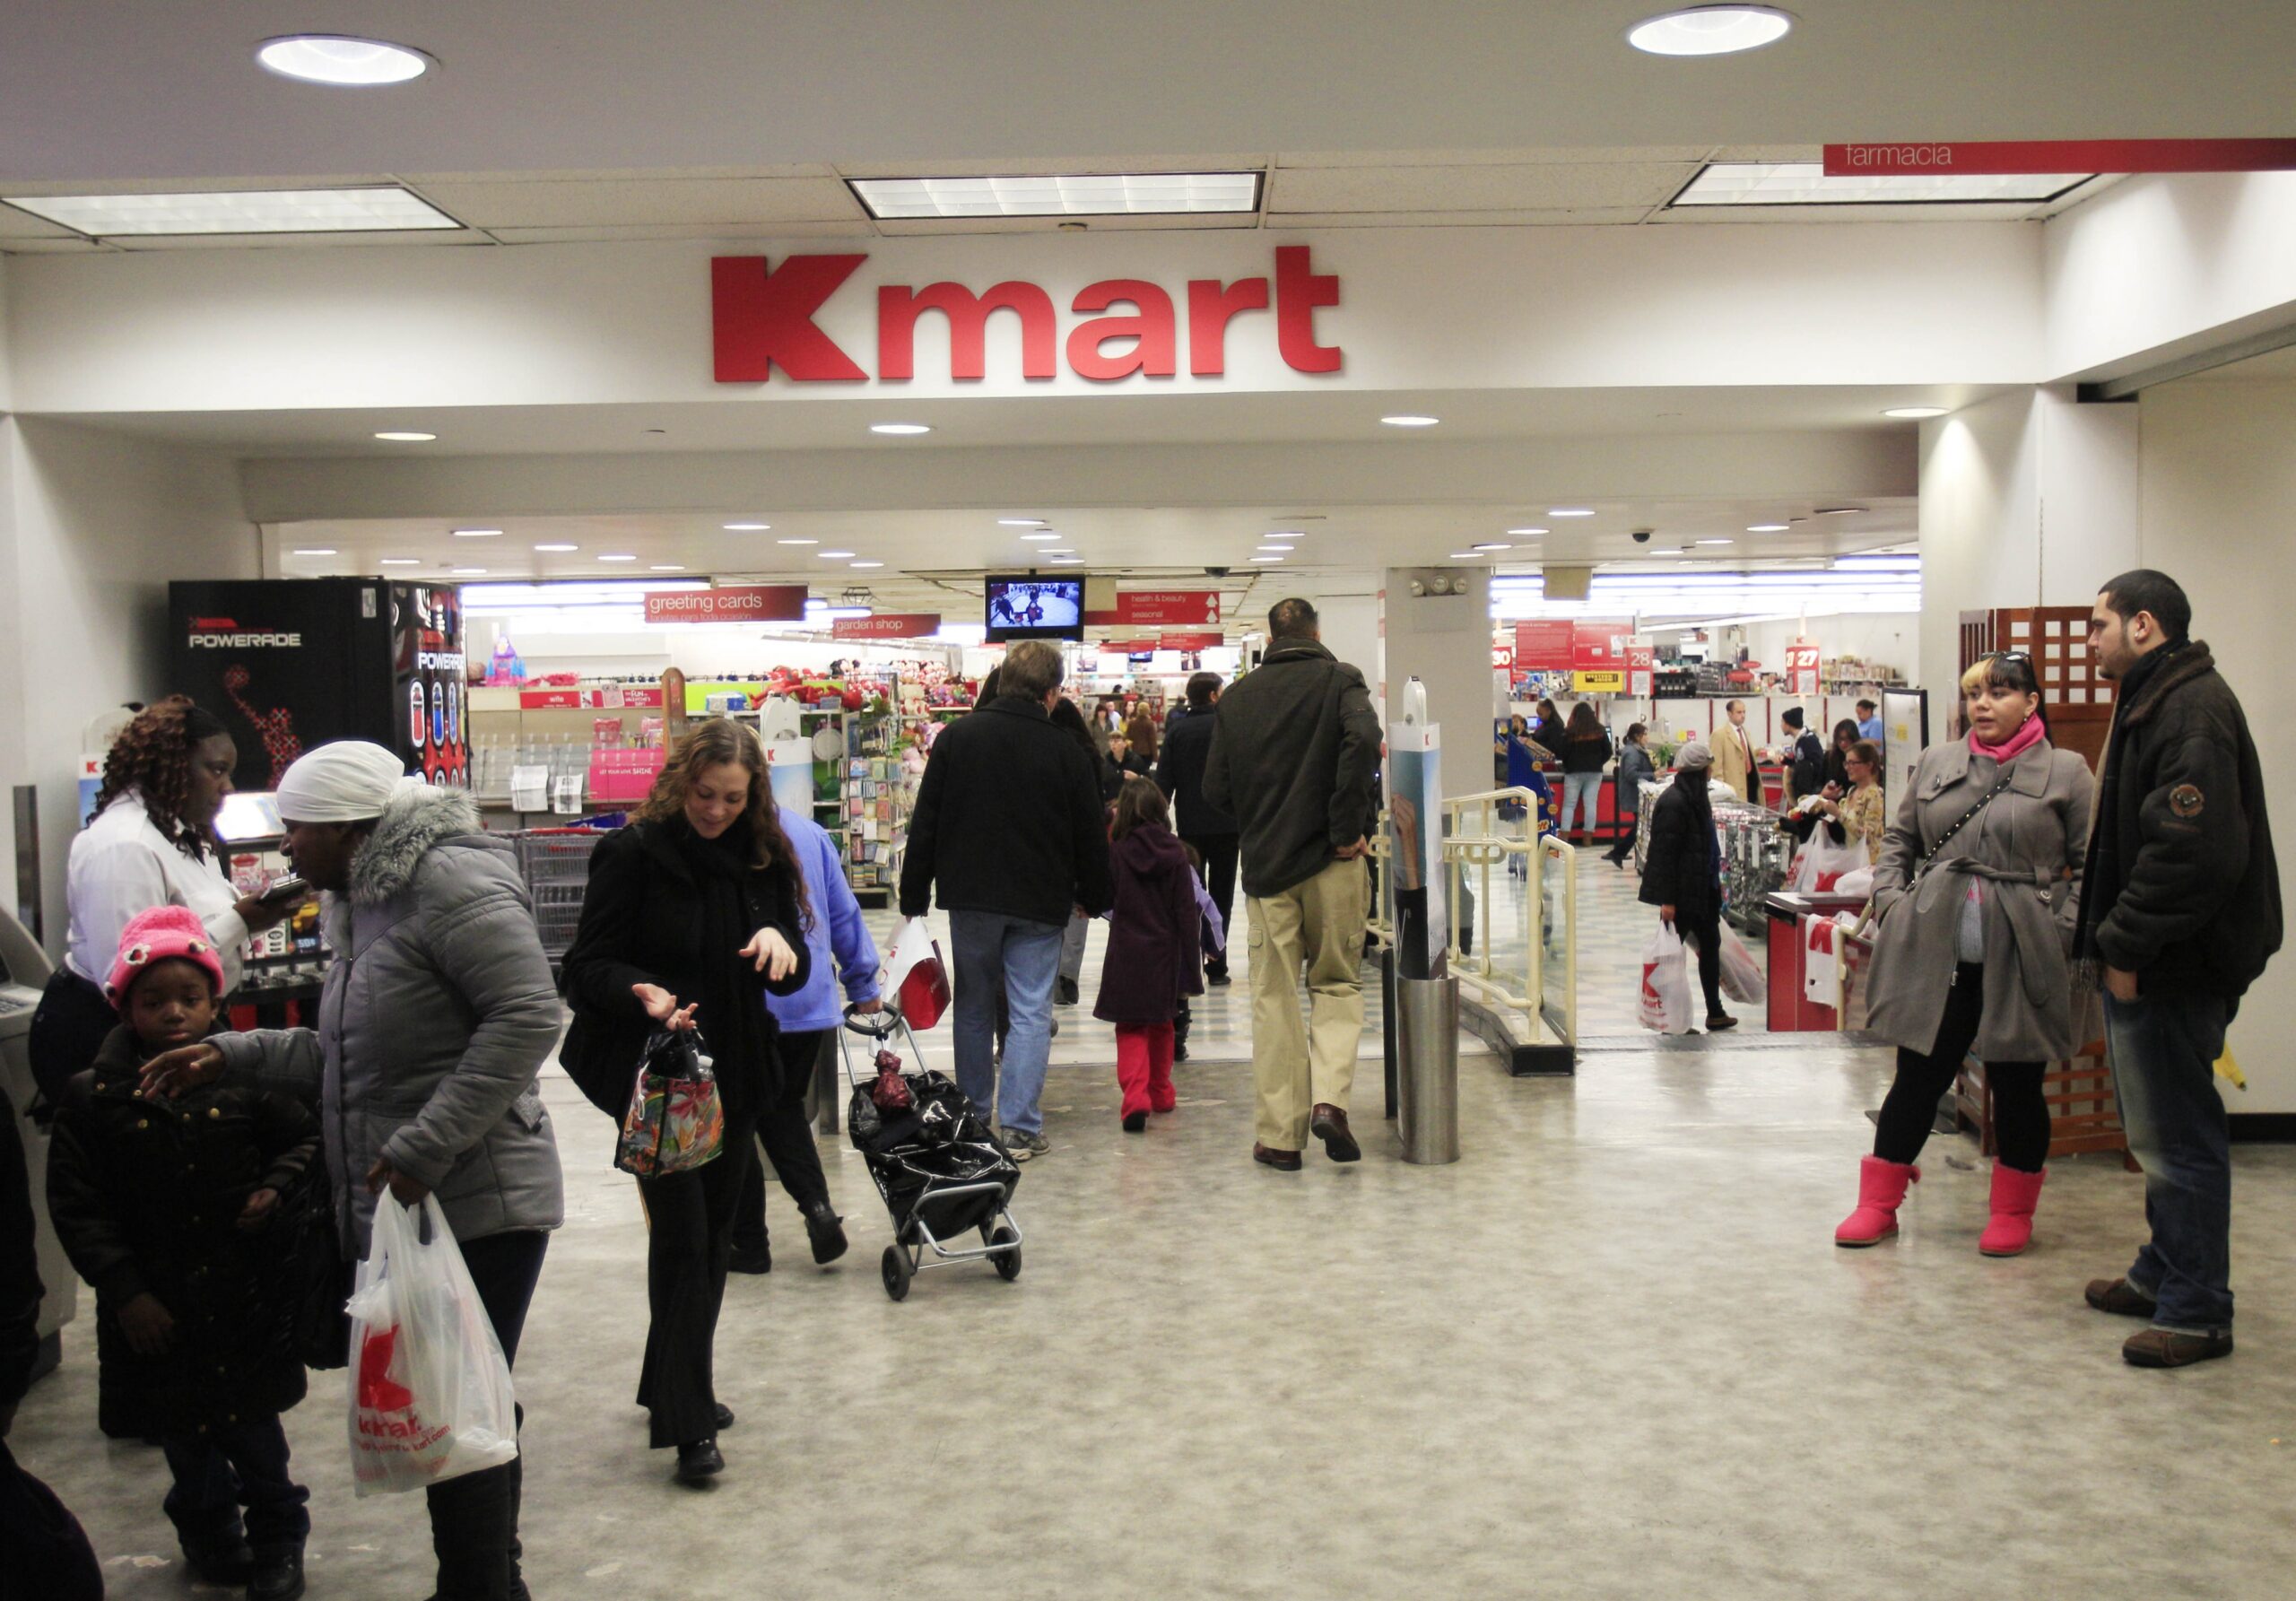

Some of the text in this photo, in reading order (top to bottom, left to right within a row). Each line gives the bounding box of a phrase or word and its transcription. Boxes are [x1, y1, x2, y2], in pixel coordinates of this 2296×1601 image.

[1846, 144, 1952, 166] farmacia
[711, 246, 1342, 382] Kmart
[649, 593, 762, 613] greeting cards
[836, 619, 903, 631] garden shop
[189, 633, 301, 648] POWERADE
[1631, 653, 1650, 666] 28
[1797, 650, 1818, 666] 27
[768, 749, 775, 761] K
[86, 761, 99, 773] K
